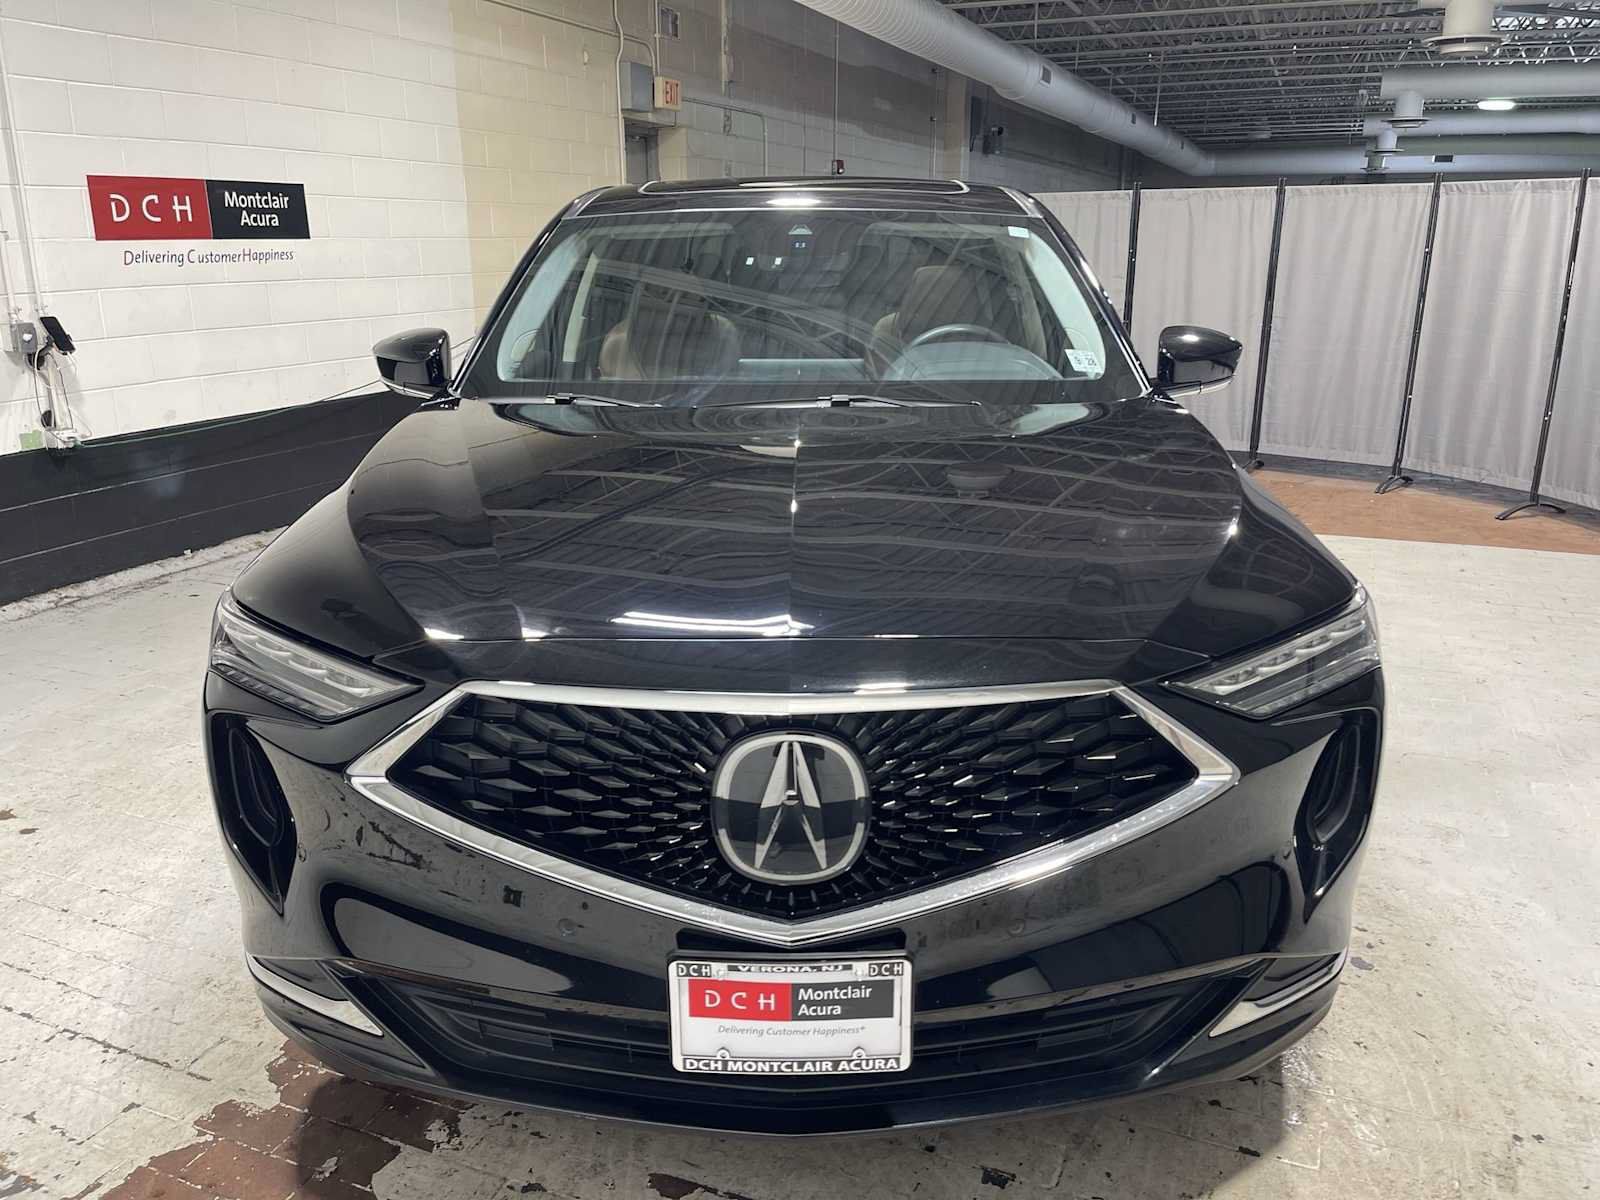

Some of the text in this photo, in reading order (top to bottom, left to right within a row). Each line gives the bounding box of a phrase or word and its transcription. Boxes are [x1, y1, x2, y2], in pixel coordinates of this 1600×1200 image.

[665, 81, 679, 104] EXIT
[224, 190, 290, 209] Montclair
[109, 193, 194, 223] DCH
[240, 210, 280, 227] Acura
[123, 249, 184, 267] Delivering
[242, 248, 294, 266] Happiness
[677, 964, 711, 977] DCH
[869, 963, 904, 976] DCH
[704, 989, 776, 1011] DCH
[798, 985, 873, 1001] Montclair
[797, 1003, 842, 1016] Acura
[718, 1025, 764, 1037] Delivering
[766, 1026, 811, 1036] Customer
[685, 1058, 899, 1073] DCH MONTCLAIR ACURA
